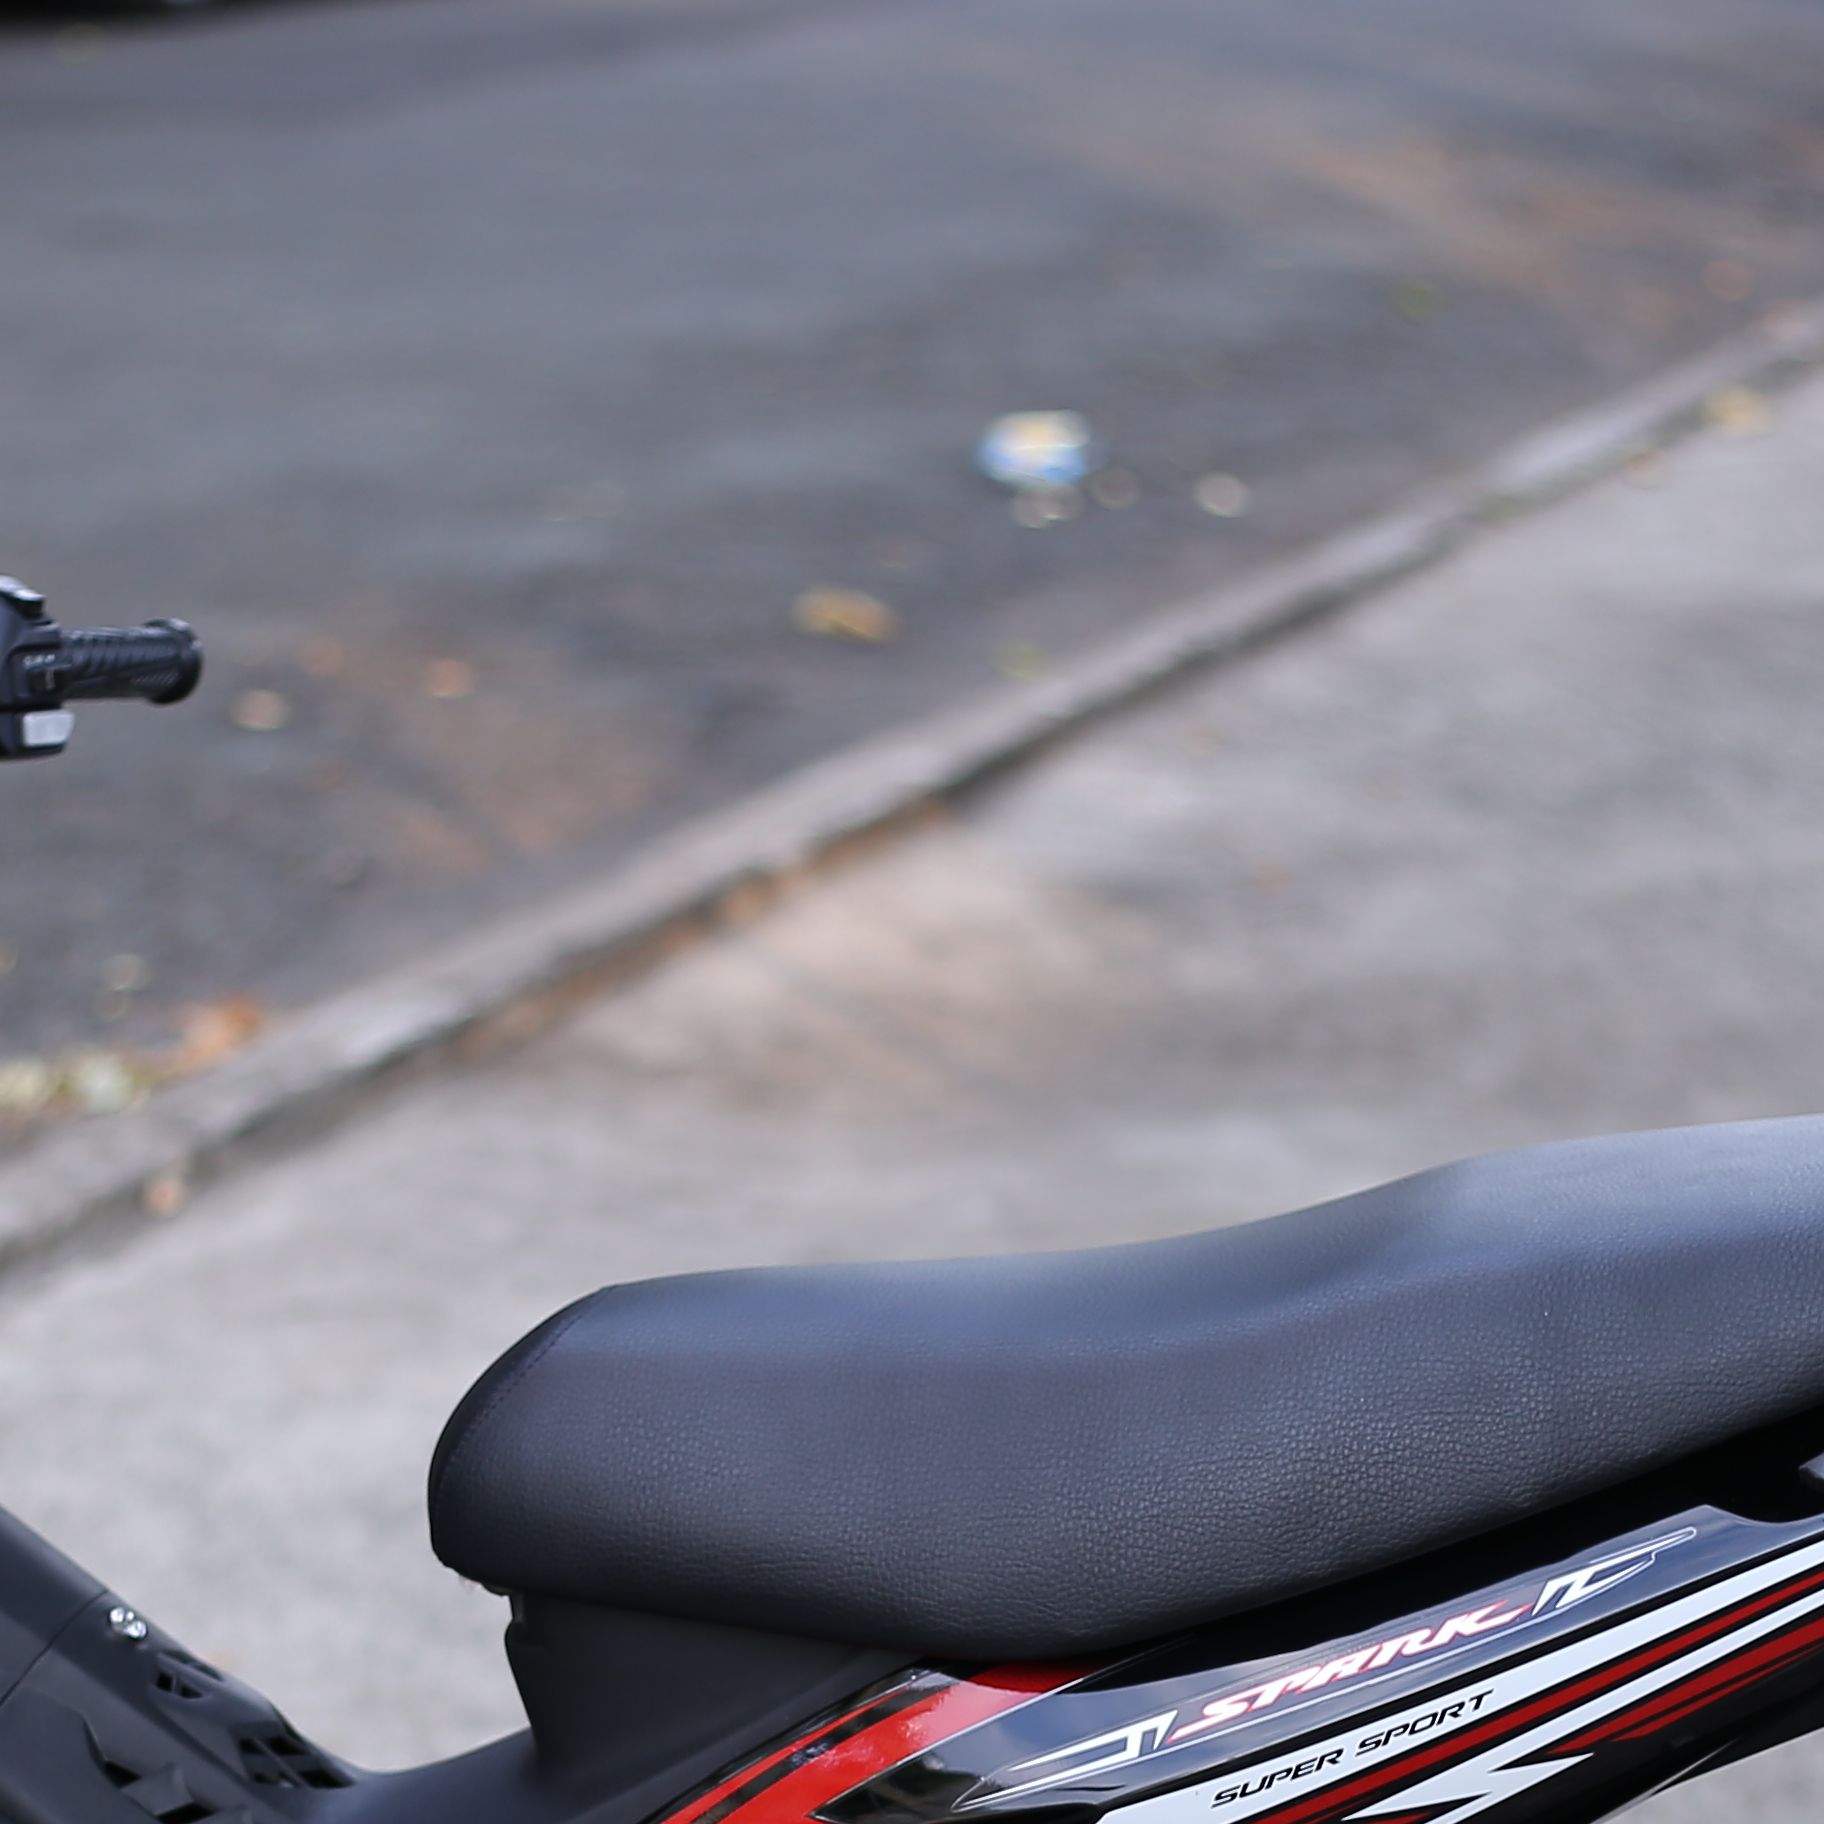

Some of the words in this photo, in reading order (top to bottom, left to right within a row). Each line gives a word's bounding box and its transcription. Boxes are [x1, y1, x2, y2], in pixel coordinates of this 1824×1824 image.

[1167, 1600, 1536, 1743] SPARK
[1211, 1746, 1346, 1808] SUPER
[1353, 1689, 1494, 1758] SPORT
